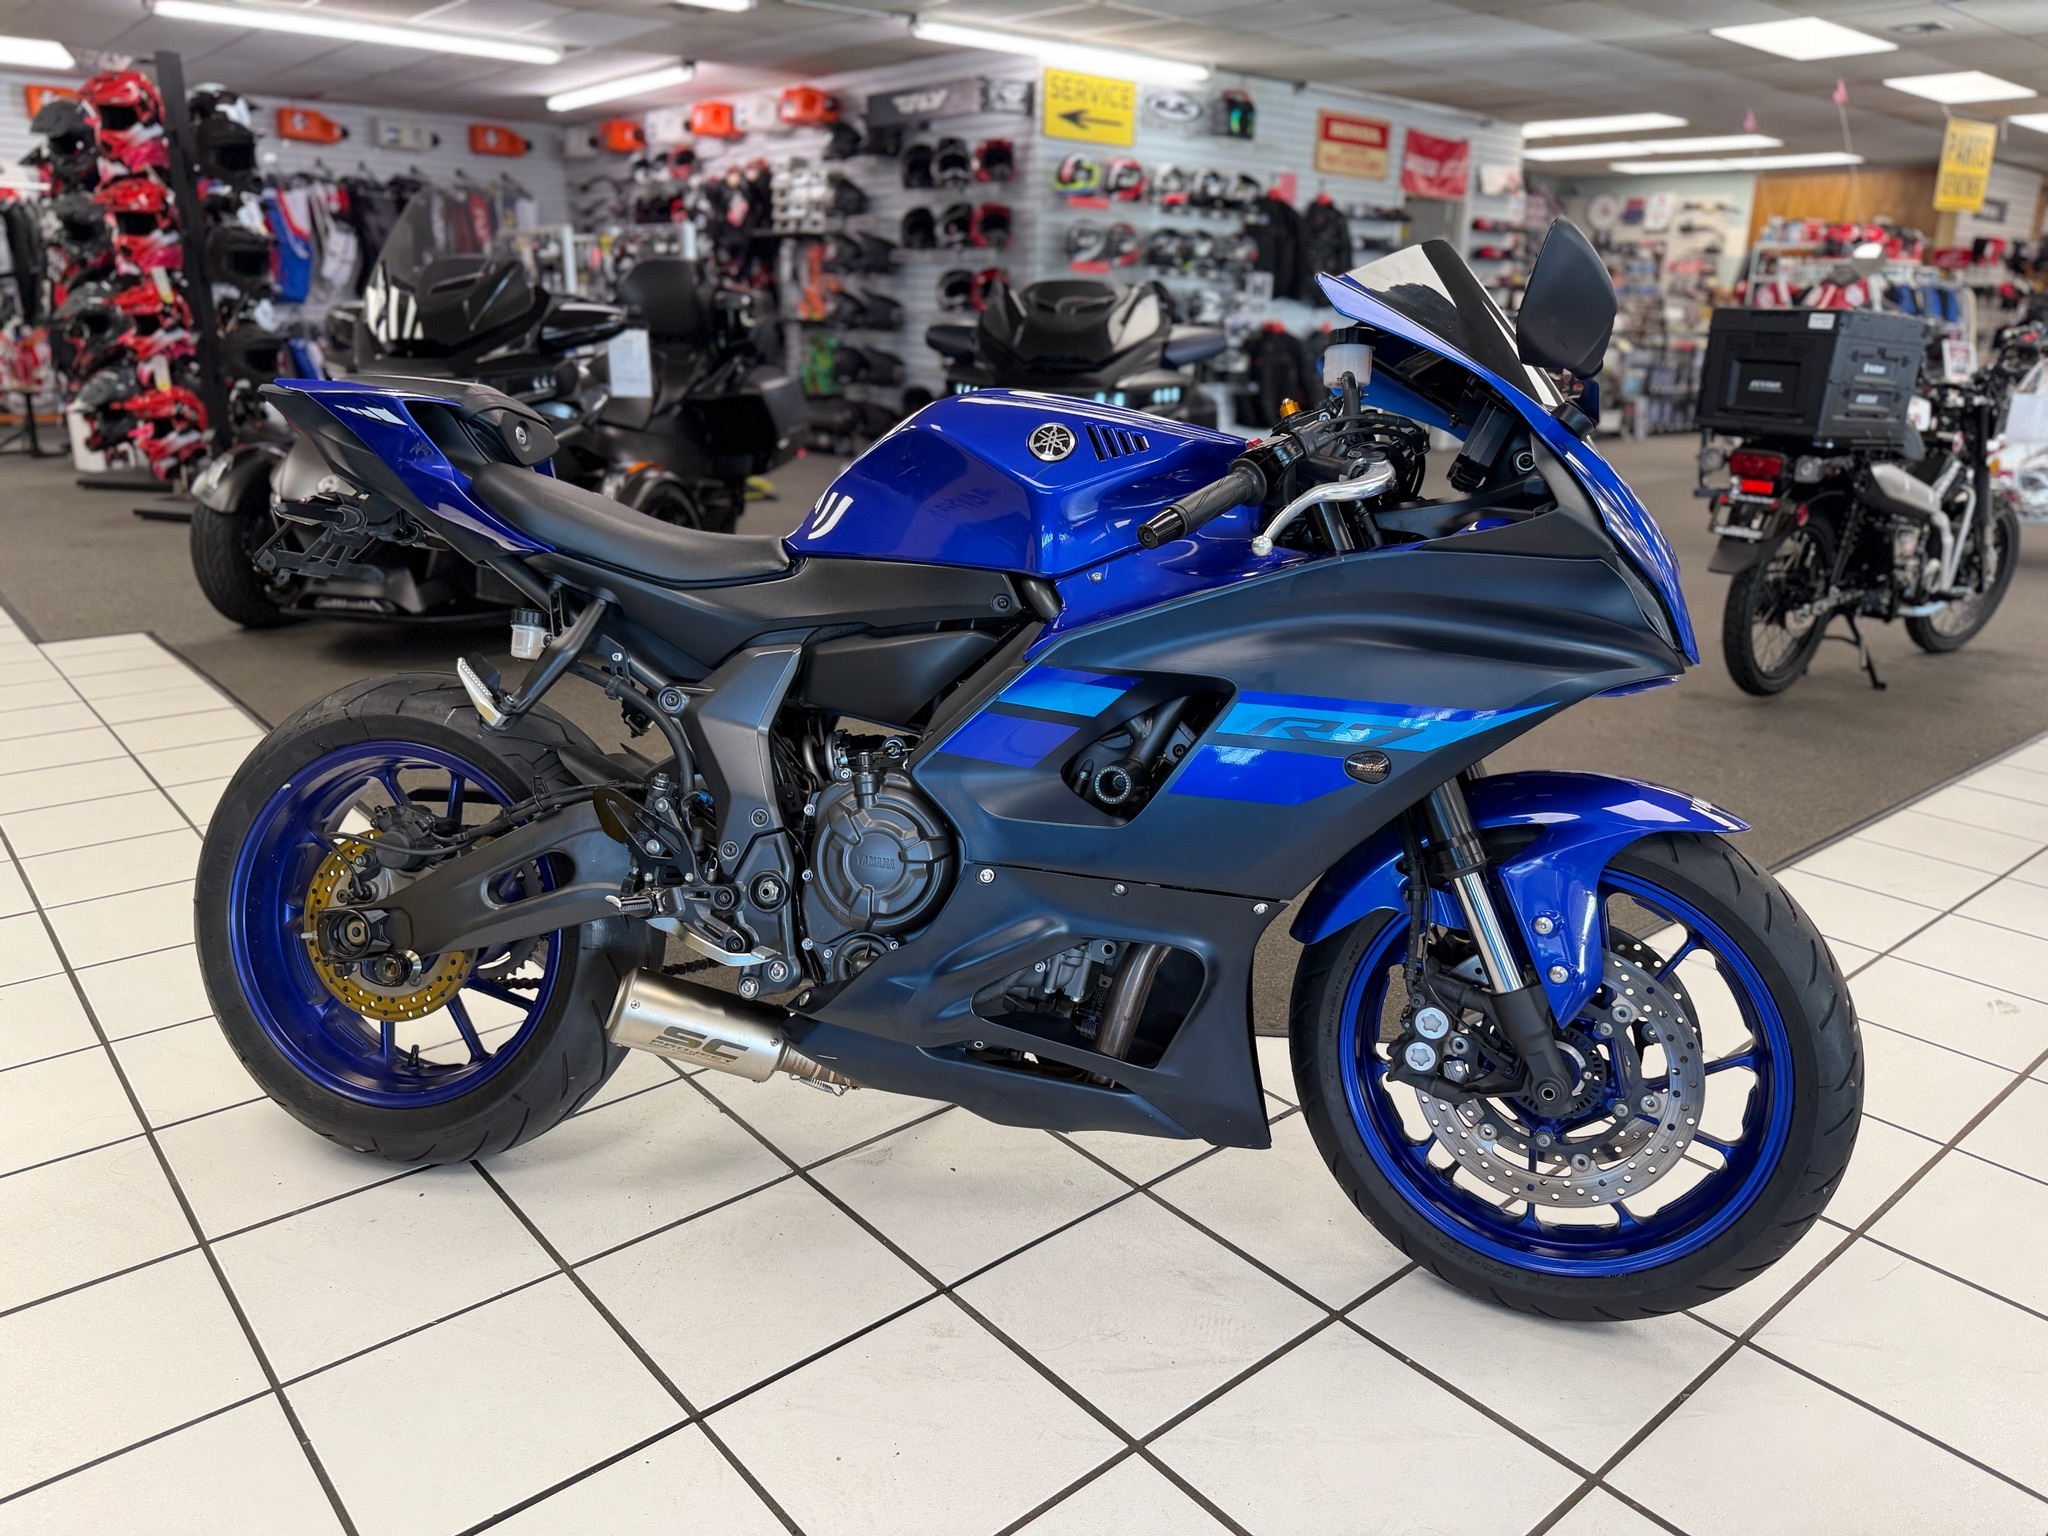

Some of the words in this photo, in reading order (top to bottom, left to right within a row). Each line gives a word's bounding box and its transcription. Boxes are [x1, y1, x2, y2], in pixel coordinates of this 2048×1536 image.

[1050, 74, 1132, 111] SERVICE
[1245, 716, 1426, 748] R7
[856, 853, 896, 870] YAMAHA
[656, 1025, 750, 1061] SC
